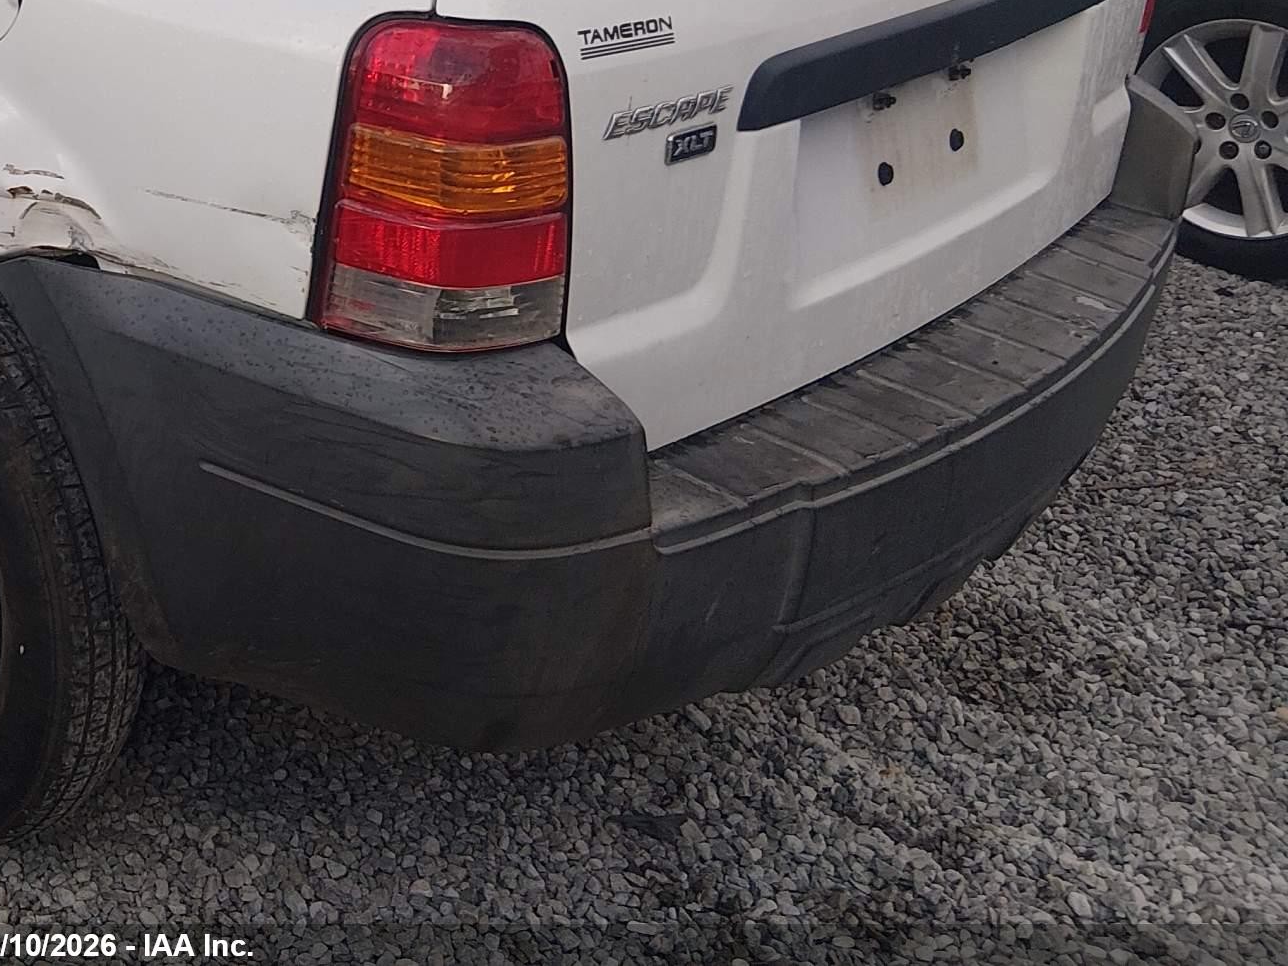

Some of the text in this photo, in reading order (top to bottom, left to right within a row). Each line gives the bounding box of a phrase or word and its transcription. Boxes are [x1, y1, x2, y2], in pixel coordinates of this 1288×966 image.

[577, 15, 674, 46] TAMERON
[603, 85, 734, 141] ESCAPE
[673, 131, 714, 157] XLT
